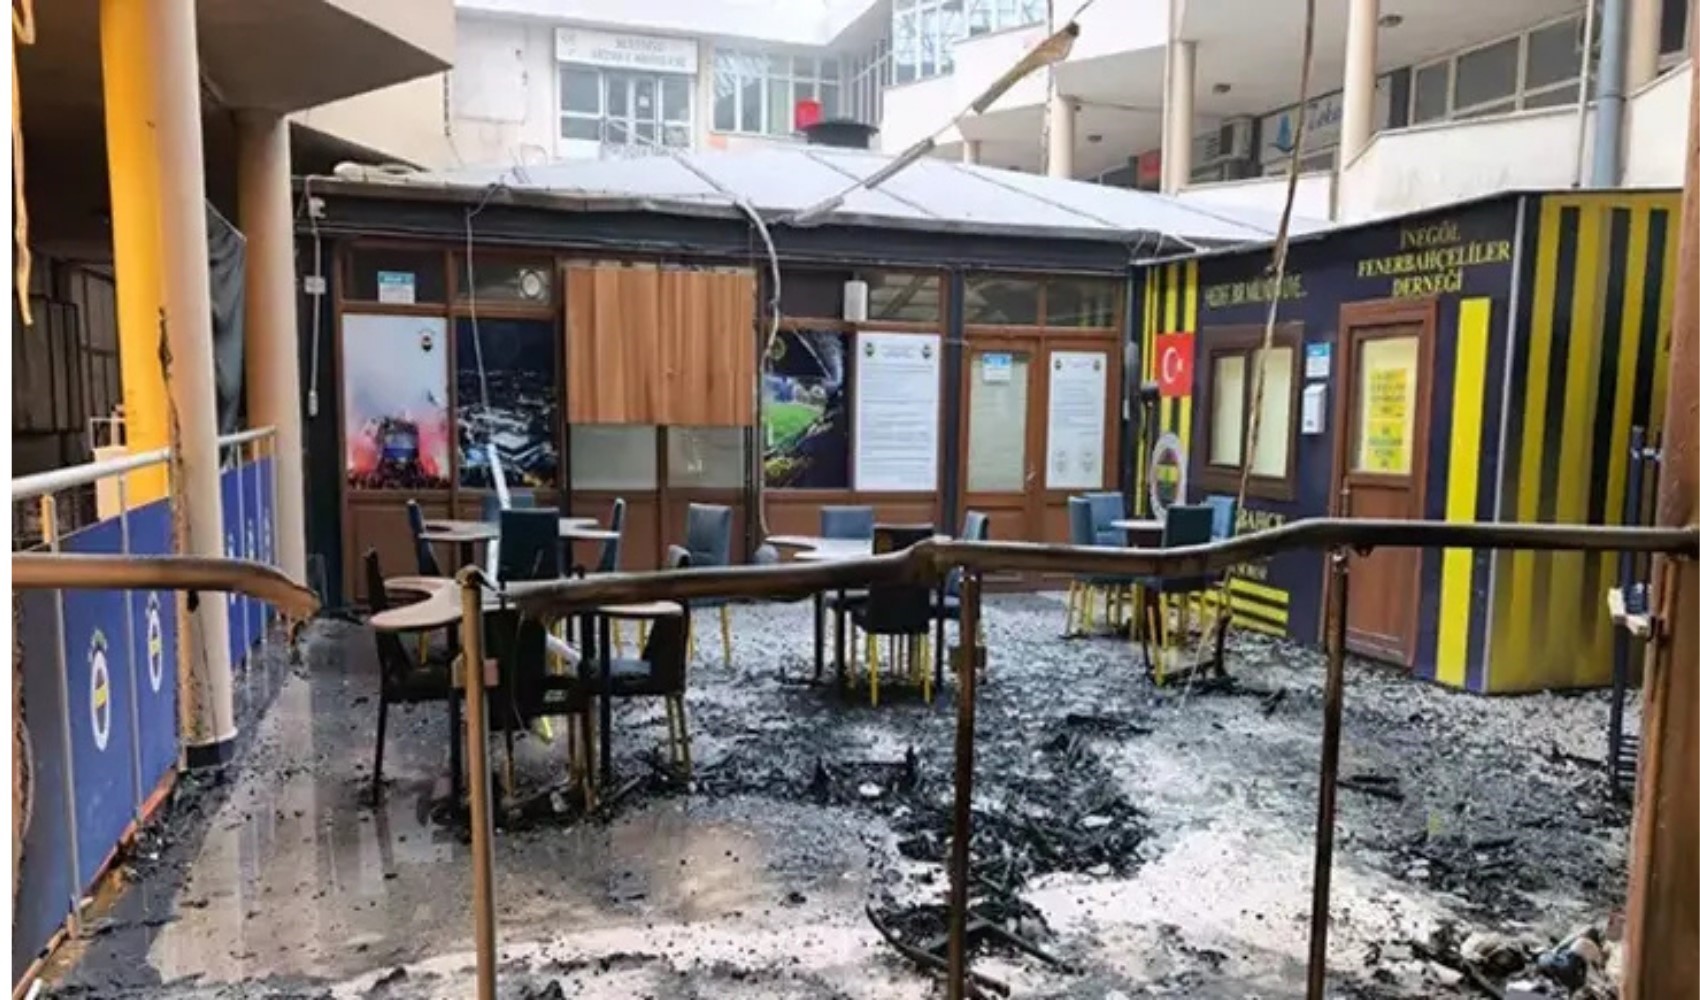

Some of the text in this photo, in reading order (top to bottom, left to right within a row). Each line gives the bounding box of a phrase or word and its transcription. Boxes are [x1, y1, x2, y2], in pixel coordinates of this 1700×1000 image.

[1401, 220, 1461, 248] İNEGÖL
[1358, 239, 1511, 277] FENERBAHÇELİLER
[1393, 266, 1464, 297] DERNEĞİ
